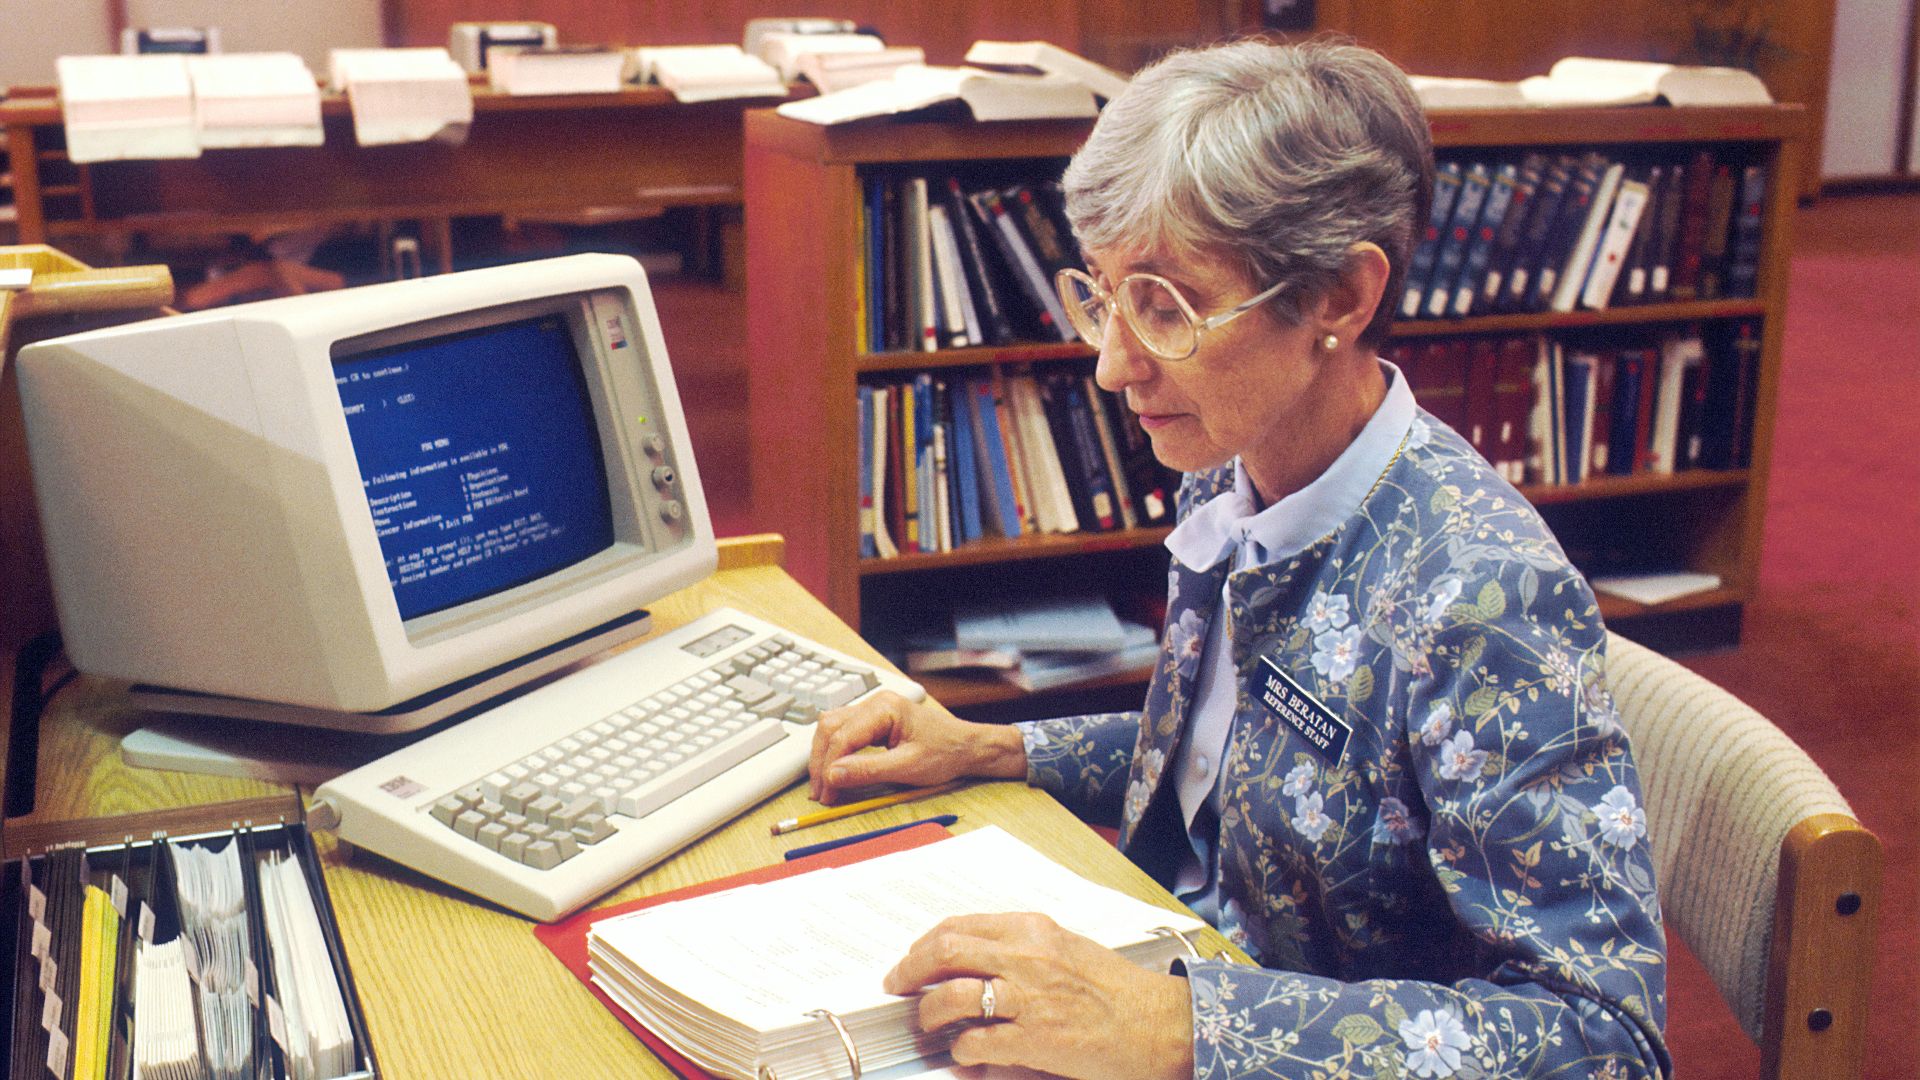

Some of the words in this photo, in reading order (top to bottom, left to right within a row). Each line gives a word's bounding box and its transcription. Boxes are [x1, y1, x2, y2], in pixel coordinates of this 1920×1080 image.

[373, 471, 407, 485] following
[410, 461, 448, 476] information
[451, 457, 458, 465] is
[460, 449, 488, 463] available
[370, 491, 412, 507] Description
[373, 500, 417, 516] Instructions
[403, 514, 442, 530] Information
[1263, 691, 1305, 730] REFERENCE
[1304, 726, 1330, 749] STAFF
[1265, 675, 1288, 700] MRS
[1288, 694, 1337, 739] BERATAN
